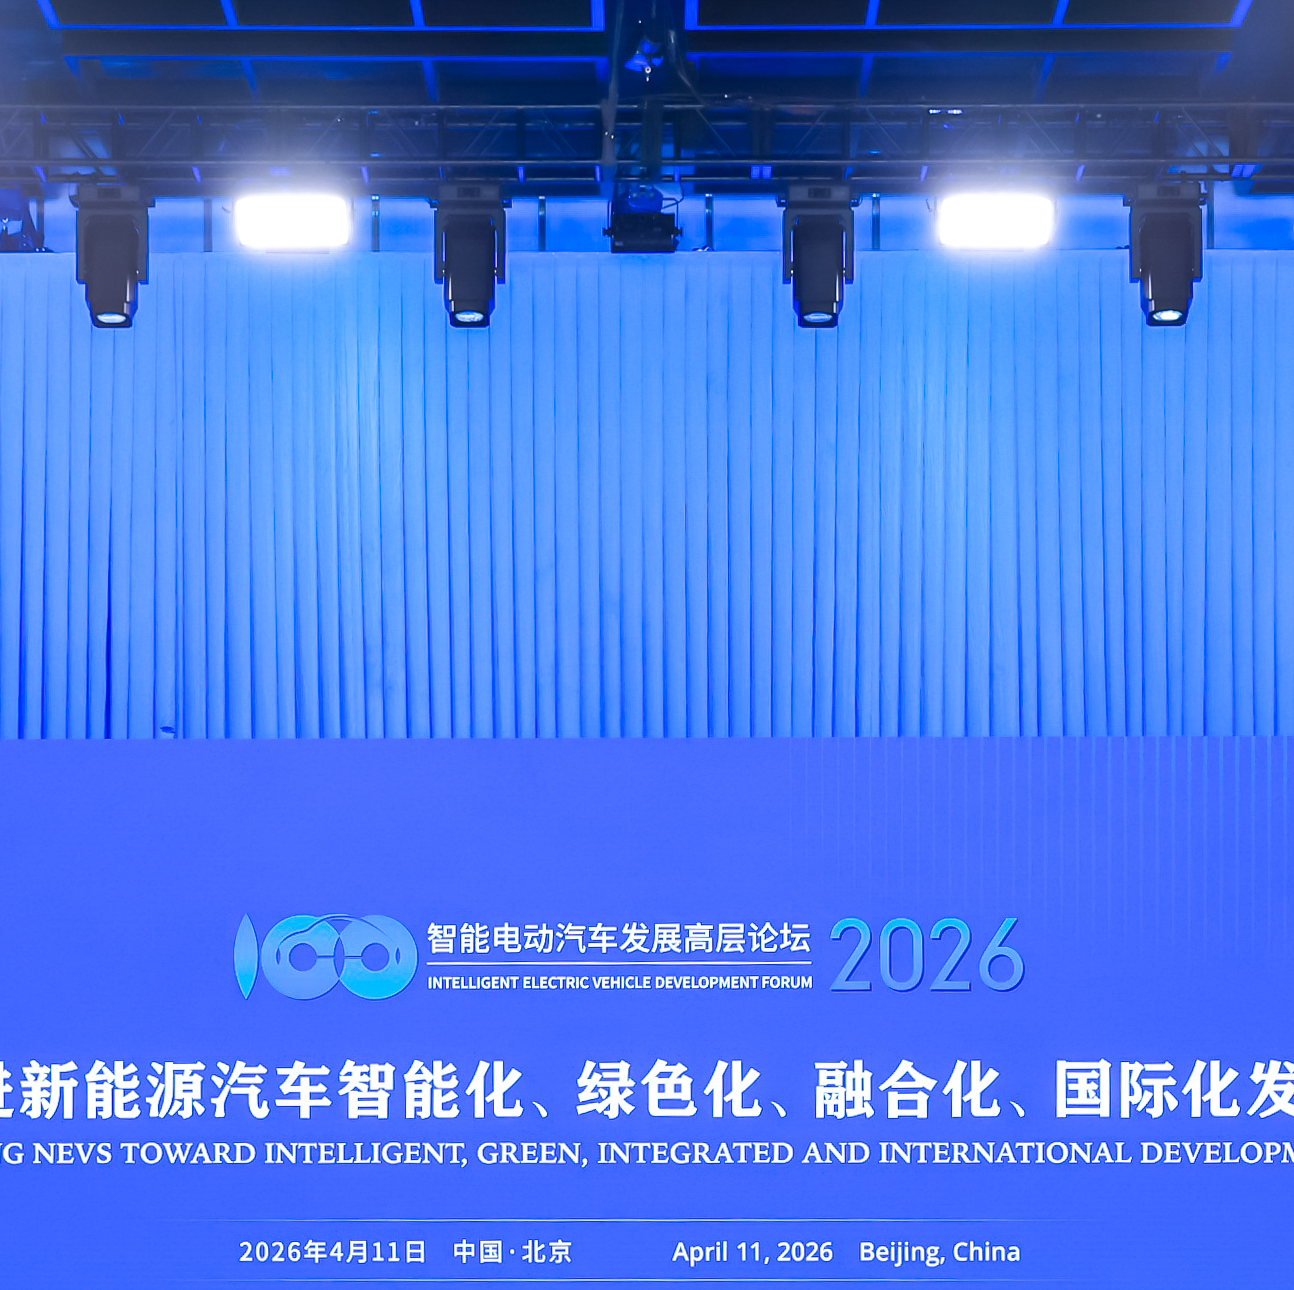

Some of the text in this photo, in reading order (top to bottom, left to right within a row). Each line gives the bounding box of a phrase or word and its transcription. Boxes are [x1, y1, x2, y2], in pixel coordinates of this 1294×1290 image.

[427, 921, 811, 954] 智能电动汽车发展高层论坛
[830, 917, 1025, 992] 2026
[428, 976, 813, 990] INTELLIGENT ELECTRIC VEHICLE DEVELOPMENT FORUM
[32, 1142, 112, 1164] NEVS
[120, 1142, 256, 1165] TOWARD
[264, 1142, 468, 1168] INTELLIGENT,
[477, 1142, 588, 1168] GREEN,
[597, 1142, 794, 1164] INTEGRATED
[801, 1142, 870, 1164] AND
[878, 1142, 1133, 1164] INTERNATIONAL
[239, 1239, 425, 1264] 2026年4月11日
[671, 1240, 1020, 1268] April 11, 2026 Beijing, China
